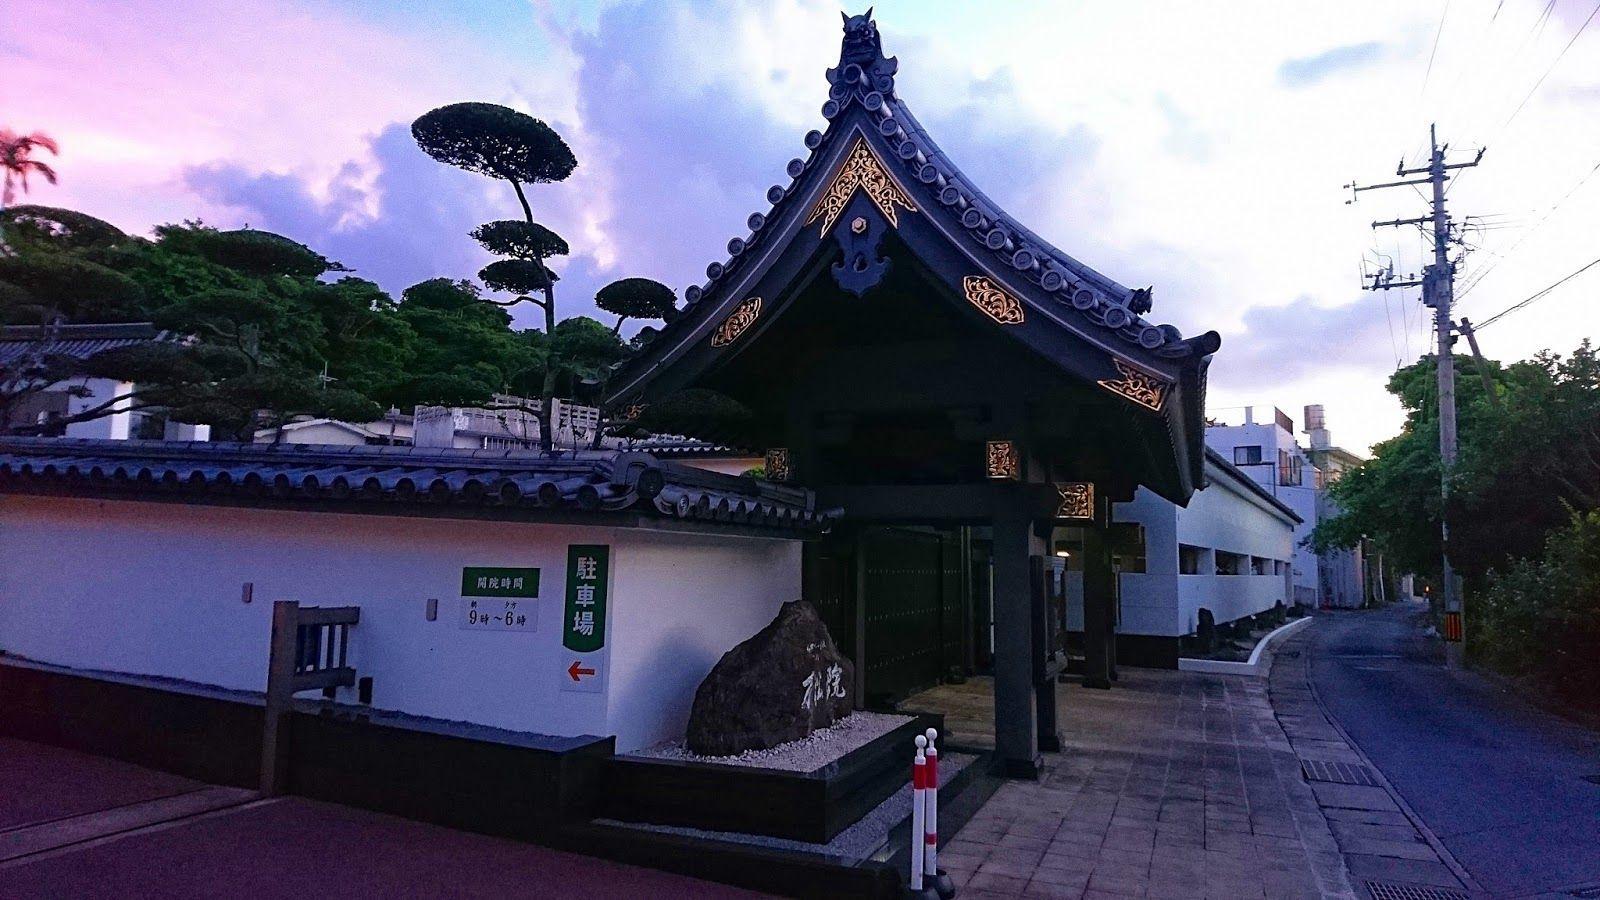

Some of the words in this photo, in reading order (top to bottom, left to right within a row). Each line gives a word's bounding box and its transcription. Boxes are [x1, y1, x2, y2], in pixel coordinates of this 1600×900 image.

[477, 576, 524, 590] 開院時間
[572, 556, 597, 636] 駐車場
[505, 601, 518, 609] 夕方
